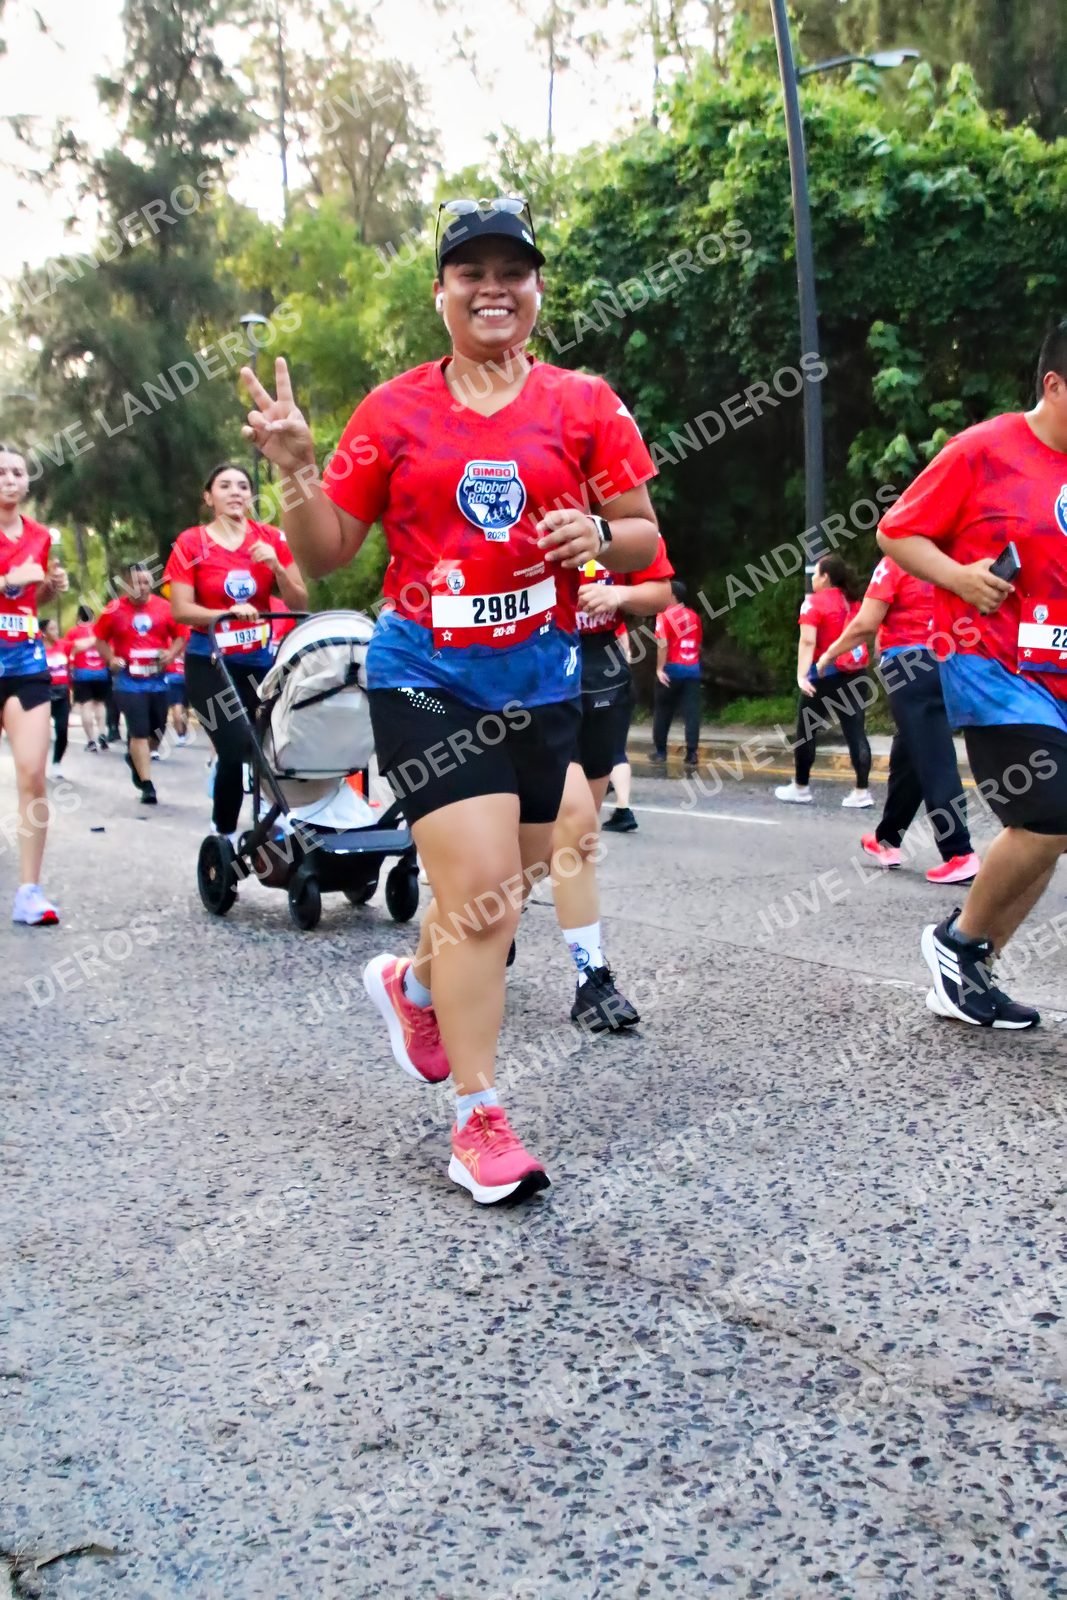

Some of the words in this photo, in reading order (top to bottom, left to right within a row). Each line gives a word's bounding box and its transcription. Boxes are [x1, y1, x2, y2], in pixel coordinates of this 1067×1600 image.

[473, 468, 511, 477] BIMBO
[474, 481, 510, 494] Global
[468, 493, 497, 504] Race
[472, 590, 530, 625] 2984
[235, 629, 256, 644] 1932
